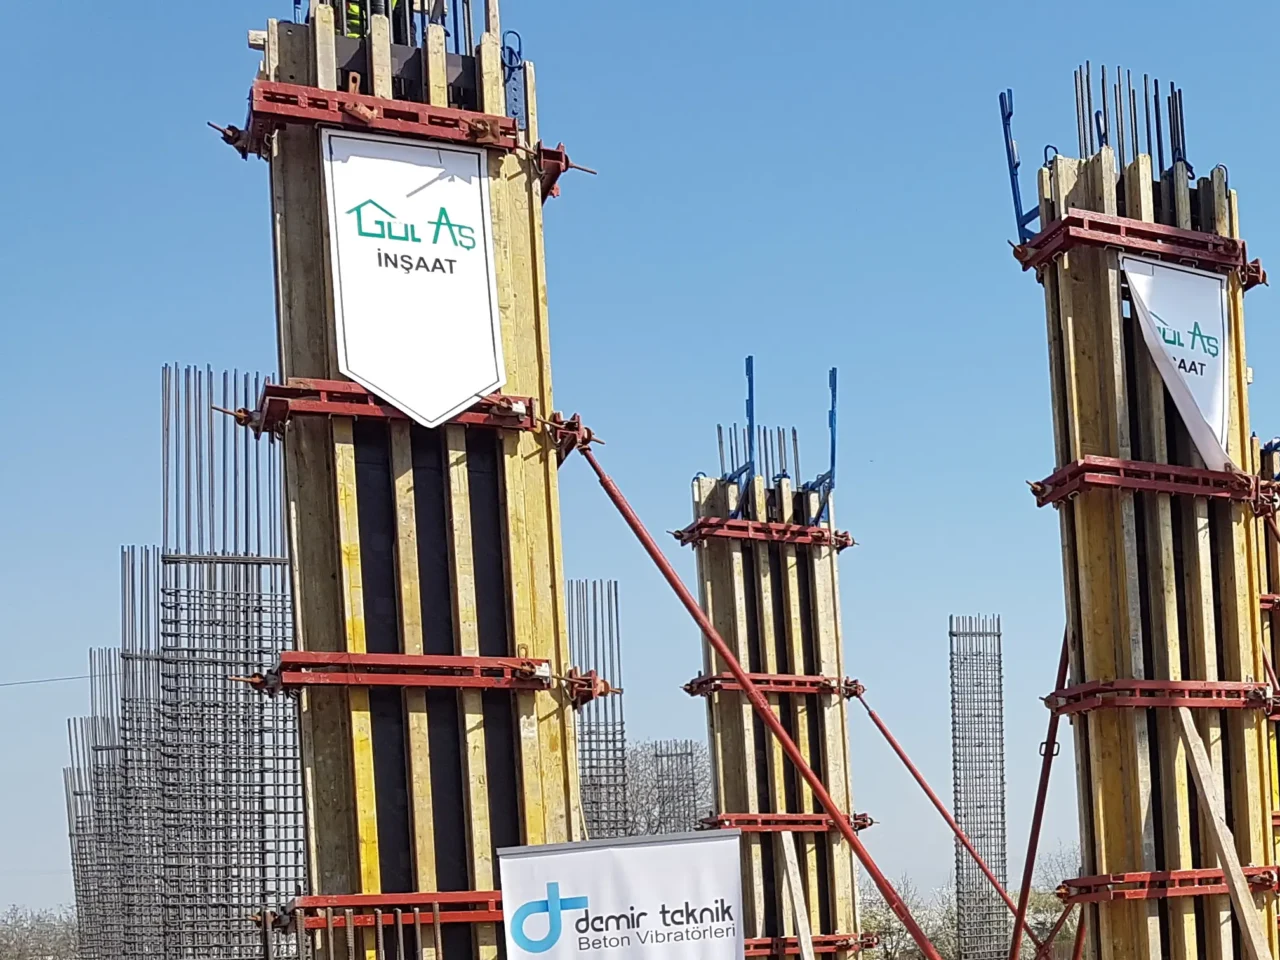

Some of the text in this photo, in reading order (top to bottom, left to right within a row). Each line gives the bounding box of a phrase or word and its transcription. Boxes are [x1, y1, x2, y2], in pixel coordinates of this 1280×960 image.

[377, 248, 457, 274] İNŞAAT
[578, 923, 736, 951] Beton Vibratörleri
